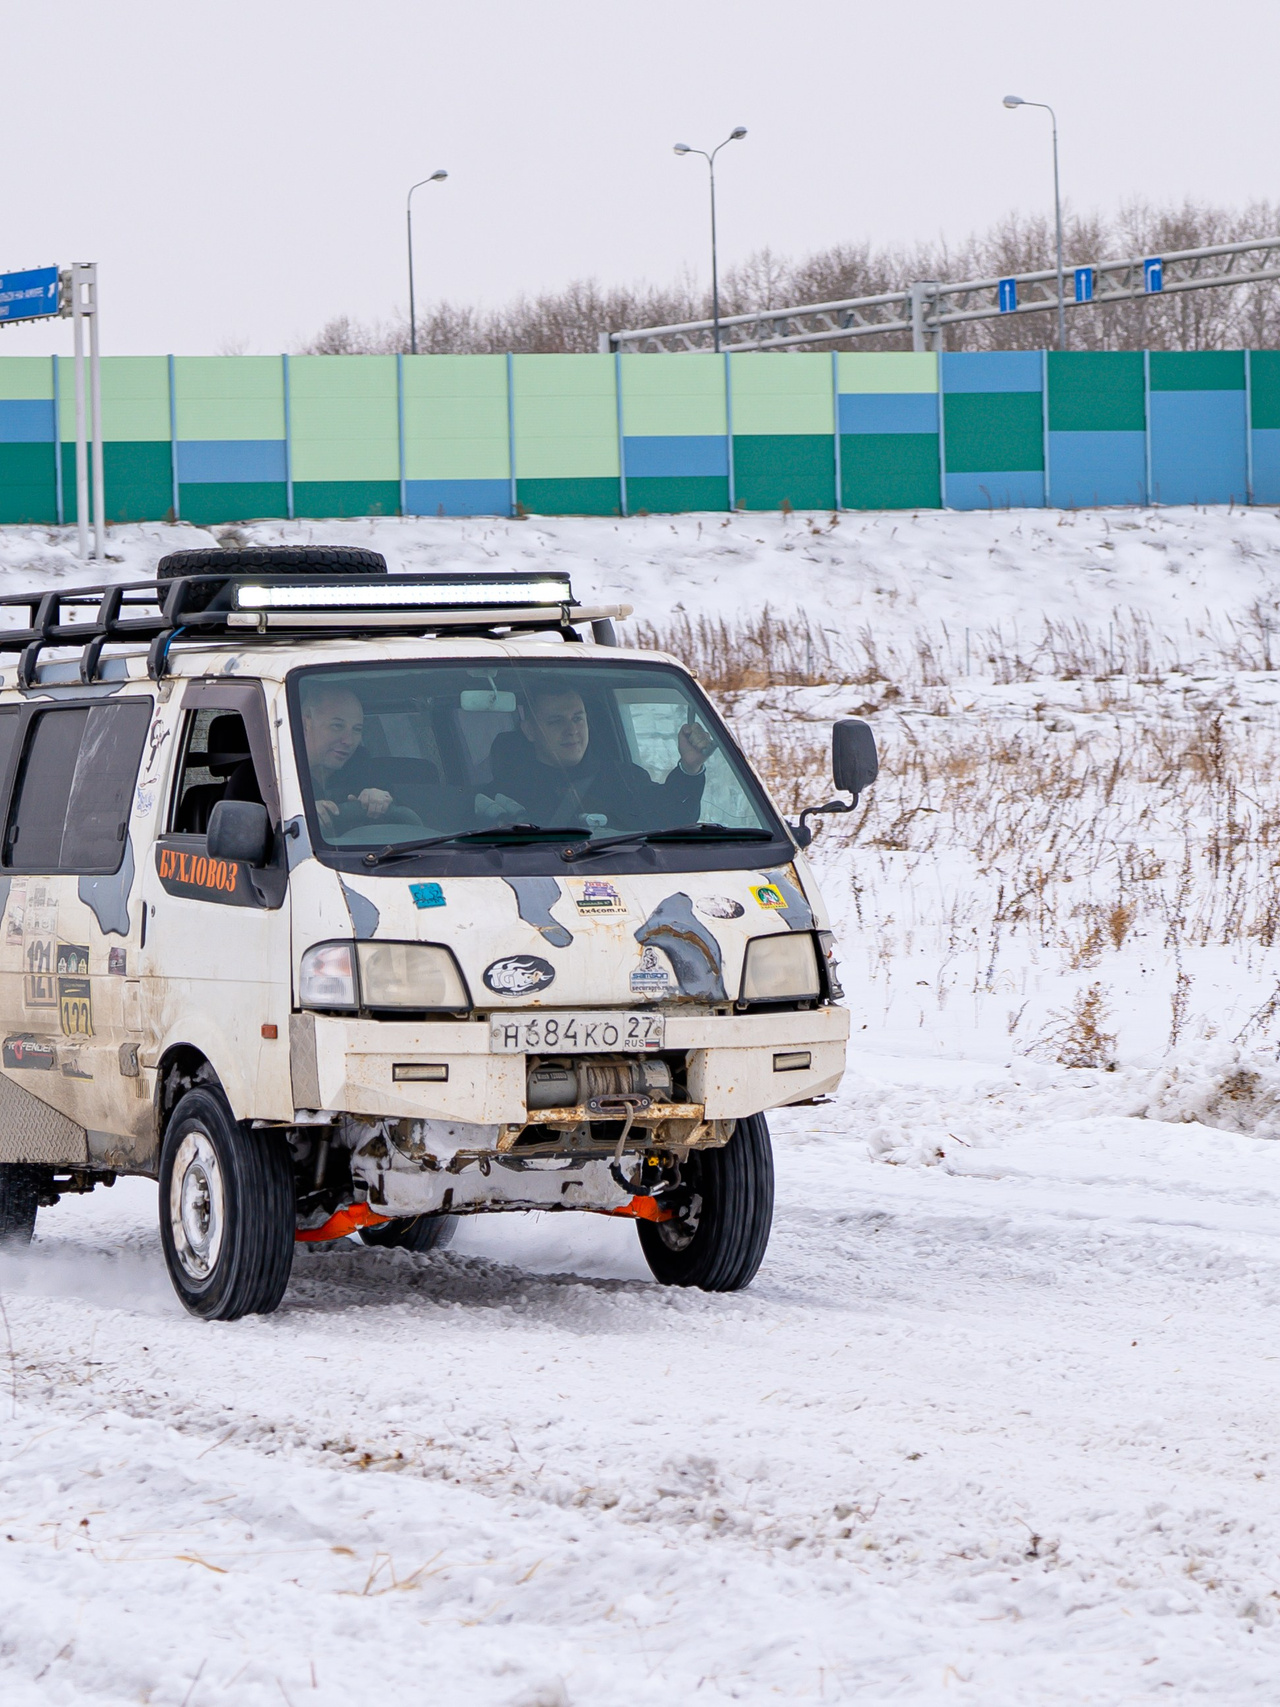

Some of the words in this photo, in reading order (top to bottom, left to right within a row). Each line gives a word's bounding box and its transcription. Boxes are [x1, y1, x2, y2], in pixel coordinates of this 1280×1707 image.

[159, 849, 238, 892] БУХЛОВОЗ
[27, 940, 53, 998] 121
[627, 1016, 655, 1038] 27
[624, 1039, 645, 1048] RUS
